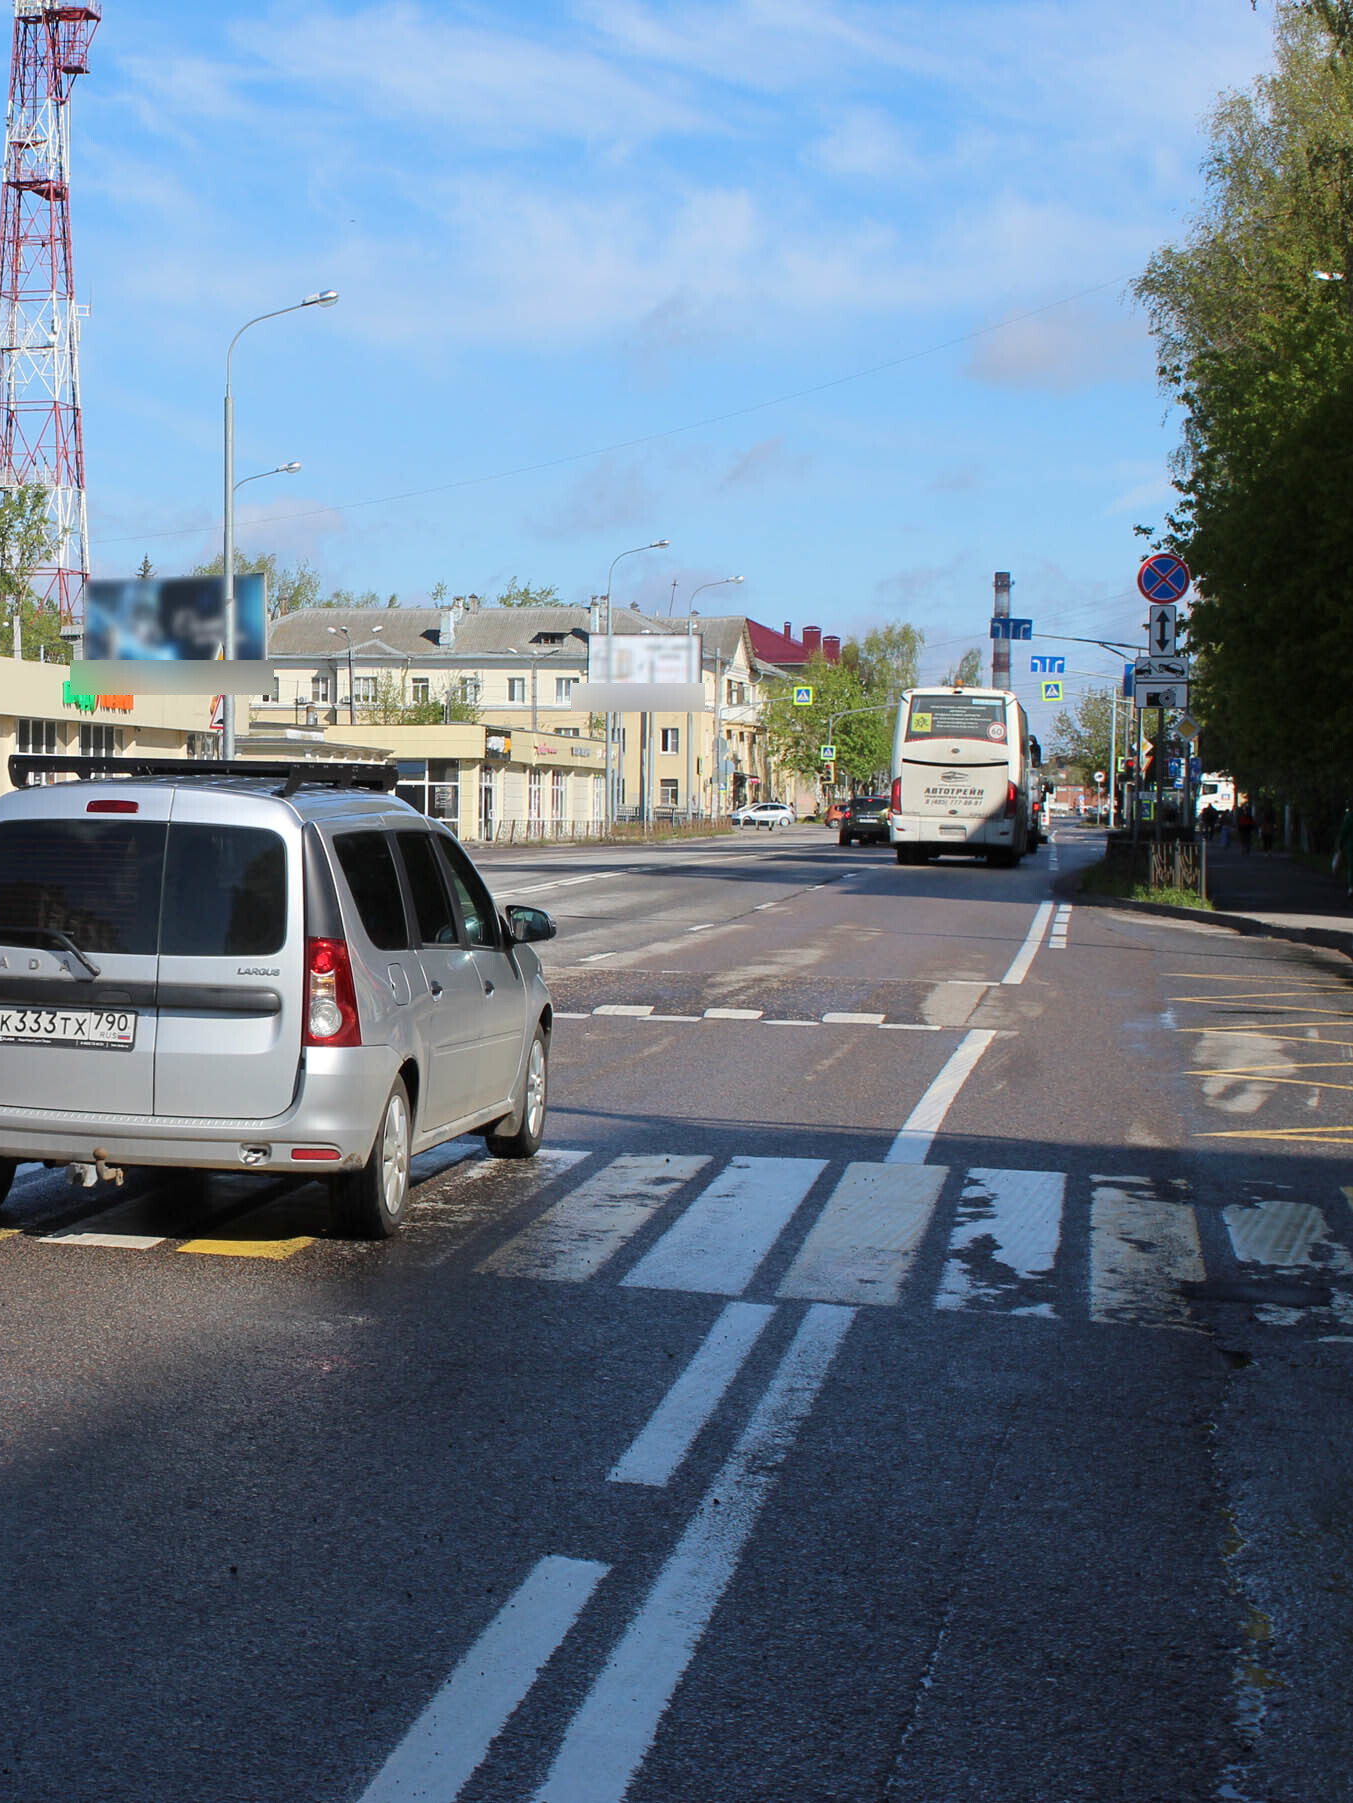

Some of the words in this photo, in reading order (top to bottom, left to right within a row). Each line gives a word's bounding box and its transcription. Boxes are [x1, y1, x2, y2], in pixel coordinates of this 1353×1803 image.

[924, 787, 985, 796] АВТОТРЕЙН
[237, 967, 280, 977] LARGUS
[94, 1012, 129, 1032] 790
[99, 1031, 118, 1040] RUS
